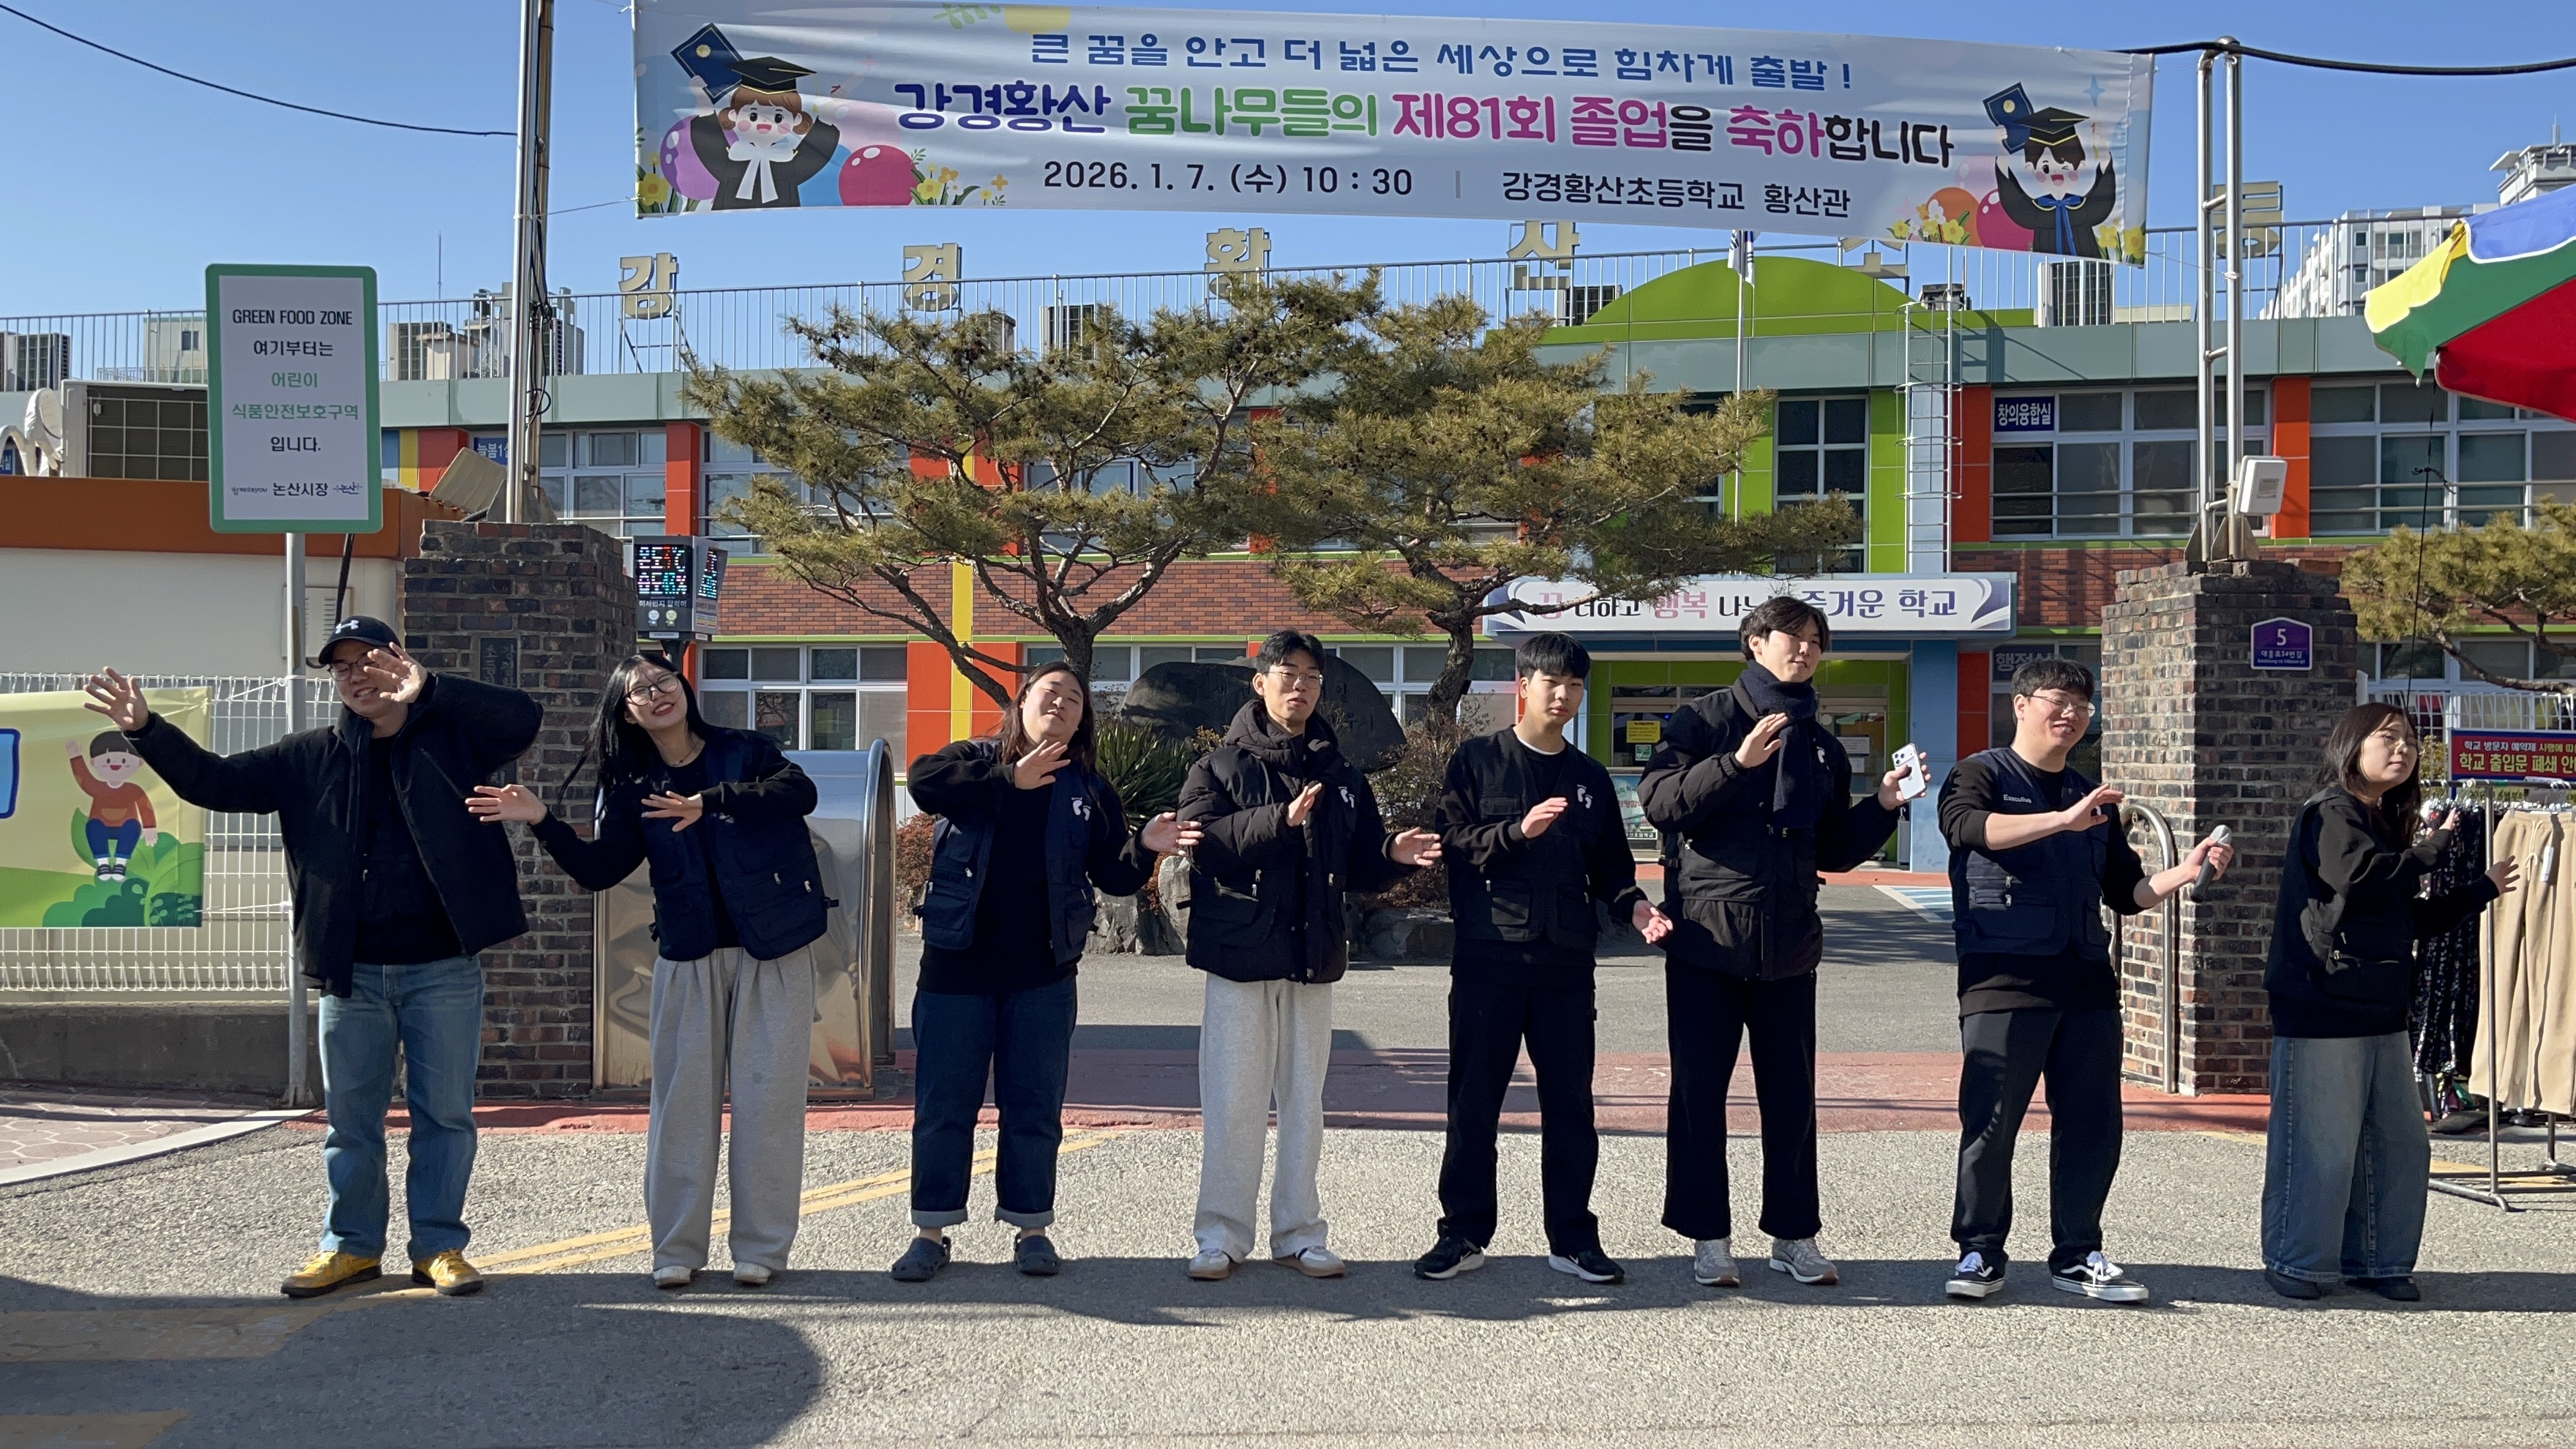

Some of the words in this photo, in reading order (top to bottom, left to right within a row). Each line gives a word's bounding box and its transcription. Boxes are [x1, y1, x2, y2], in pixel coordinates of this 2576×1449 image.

[1032, 34, 1069, 64] 큰
[1088, 33, 1168, 67] 꿈을
[1185, 36, 1267, 68] 안고
[1284, 40, 1321, 70] 더
[1338, 40, 1419, 73] 넓은
[1437, 44, 1600, 78] 세상으로
[1614, 48, 1734, 86] 힘차게
[1750, 55, 1827, 91] 출발
[894, 80, 1112, 134] 강경황산
[1124, 87, 1377, 137] 꿈나무들의
[1392, 93, 1556, 143] 제81회
[1570, 96, 1713, 151] 졸업을
[1726, 104, 1955, 168] 축하합니다
[1044, 161, 1138, 190] 2026.
[1230, 163, 1287, 194] (수)
[1502, 171, 1745, 211] 강경황산초등학교
[1763, 182, 1851, 218] 황산관
[233, 310, 274, 324] GREEN
[280, 310, 315, 325] FOOD
[320, 311, 353, 326] ZONE
[254, 340, 333, 357] 여기부터는
[272, 372, 318, 388] 어린이
[232, 404, 359, 420] 식품안전보호구역
[1998, 403, 2051, 426] 창의융합실
[271, 437, 321, 452] 입니다.
[477, 443, 509, 459] 늘봄1
[273, 483, 329, 497] 논산시장
[1899, 590, 1958, 618] 학교
[2277, 629, 2287, 645] 5
[1995, 652, 2052, 672] 행정
[2464, 741, 2481, 751] 학교
[2484, 741, 2509, 752] 방문자
[2566, 744, 2576, 753] 따
[2460, 752, 2485, 771] 학교
[2490, 753, 2528, 773] 출입문
[2531, 755, 2557, 774] 폐쇄
[2561, 756, 2576, 774] 안
[2003, 794, 2032, 804] Executive
